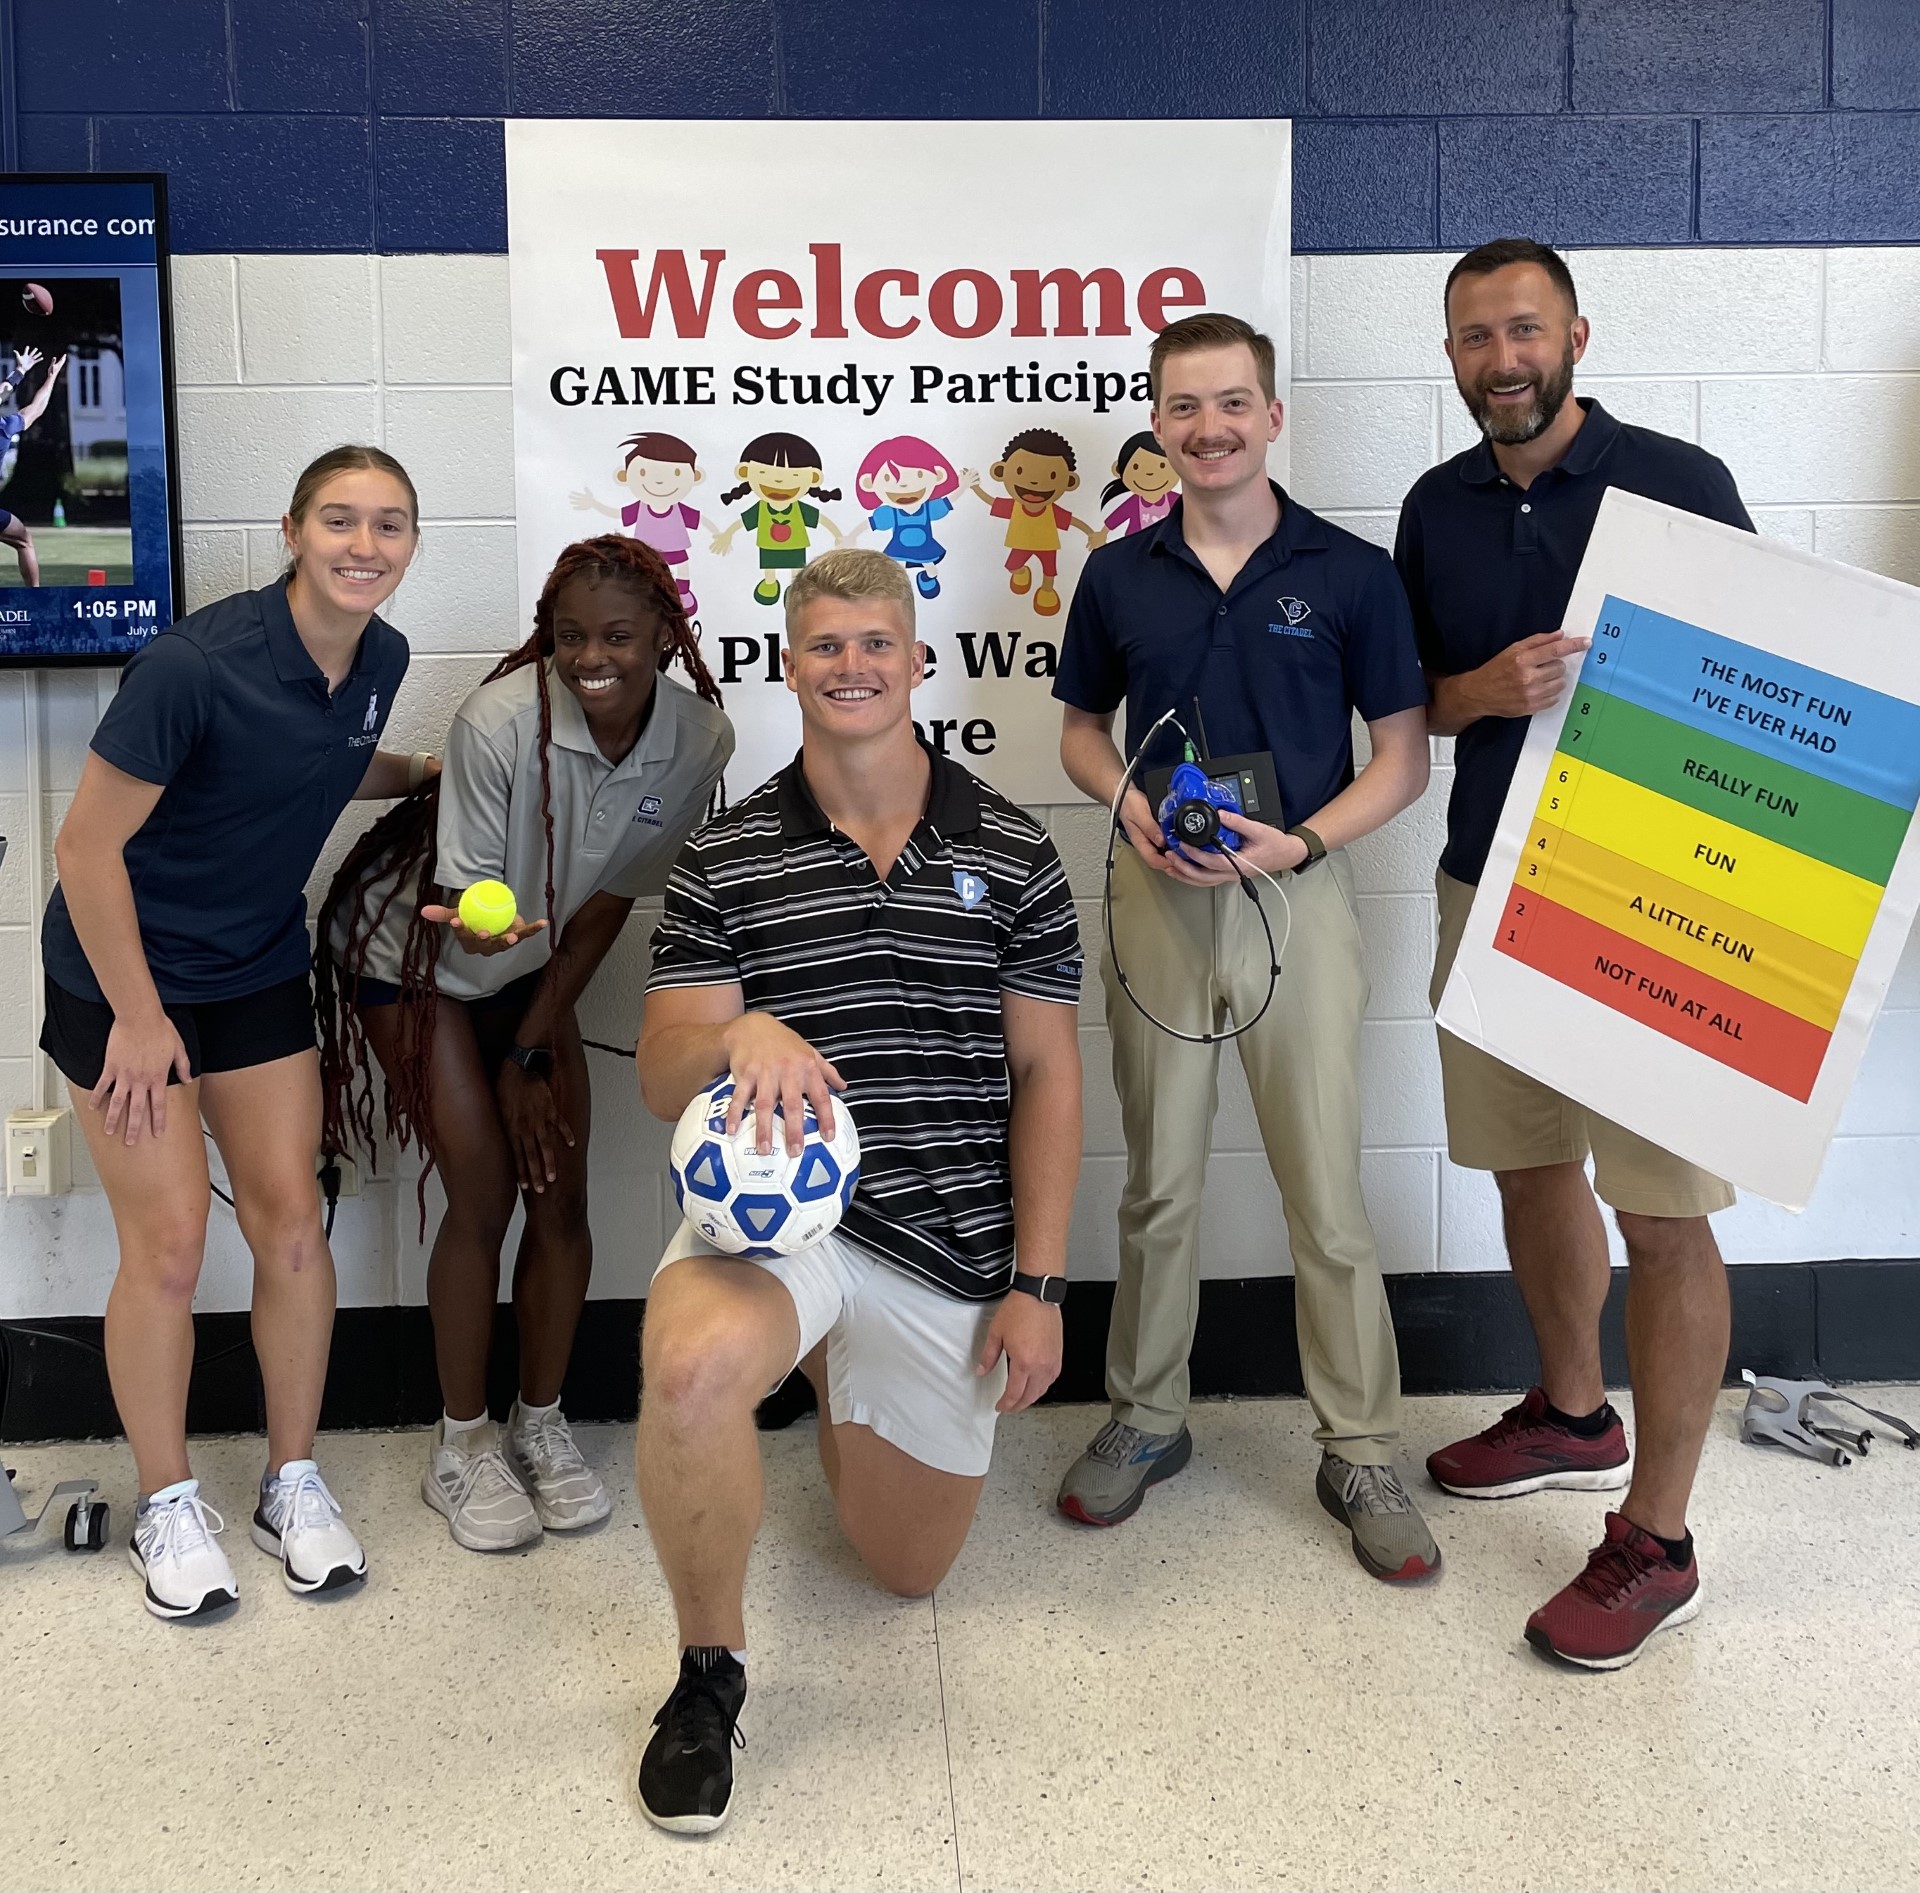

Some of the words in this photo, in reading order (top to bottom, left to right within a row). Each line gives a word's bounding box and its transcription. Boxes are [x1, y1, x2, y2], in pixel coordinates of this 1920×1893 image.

[0, 218, 98, 236] surance
[596, 243, 1207, 339] Welcome
[550, 366, 715, 406] GAME
[733, 364, 894, 415] Study
[910, 360, 1155, 414] Participa
[73, 600, 118, 619] 1:05
[124, 599, 157, 618] PM
[127, 626, 149, 638] July
[150, 625, 158, 636] 6
[1268, 623, 1284, 634] THE
[1602, 623, 1620, 639] 10
[956, 631, 1058, 679] Wa
[1597, 652, 1607, 665] 9
[1701, 656, 1738, 684] THE
[1741, 674, 1804, 708] MOST
[1806, 698, 1852, 726] FUN
[1580, 702, 1591, 716] 8
[1572, 729, 1583, 743] 7
[1734, 704, 1786, 736] EVER
[1790, 724, 1837, 753] HAD
[1559, 770, 1569, 783] 6
[1682, 758, 1753, 798] REALLY
[1754, 787, 1800, 818] FUN
[1550, 797, 1559, 810] 5
[1537, 838, 1546, 850] 4
[1694, 843, 1736, 874] FUN
[1529, 864, 1538, 876] 3
[1516, 903, 1525, 916] 2
[1508, 929, 1516, 943] 1
[1629, 897, 1642, 913] A
[1648, 902, 1709, 942] LITTLE
[1711, 931, 1754, 963] FUN
[1595, 955, 1636, 985] NOT
[1638, 978, 1678, 1008] FUN
[1680, 1000, 1708, 1020] AT
[1708, 1014, 1742, 1041] ALL
